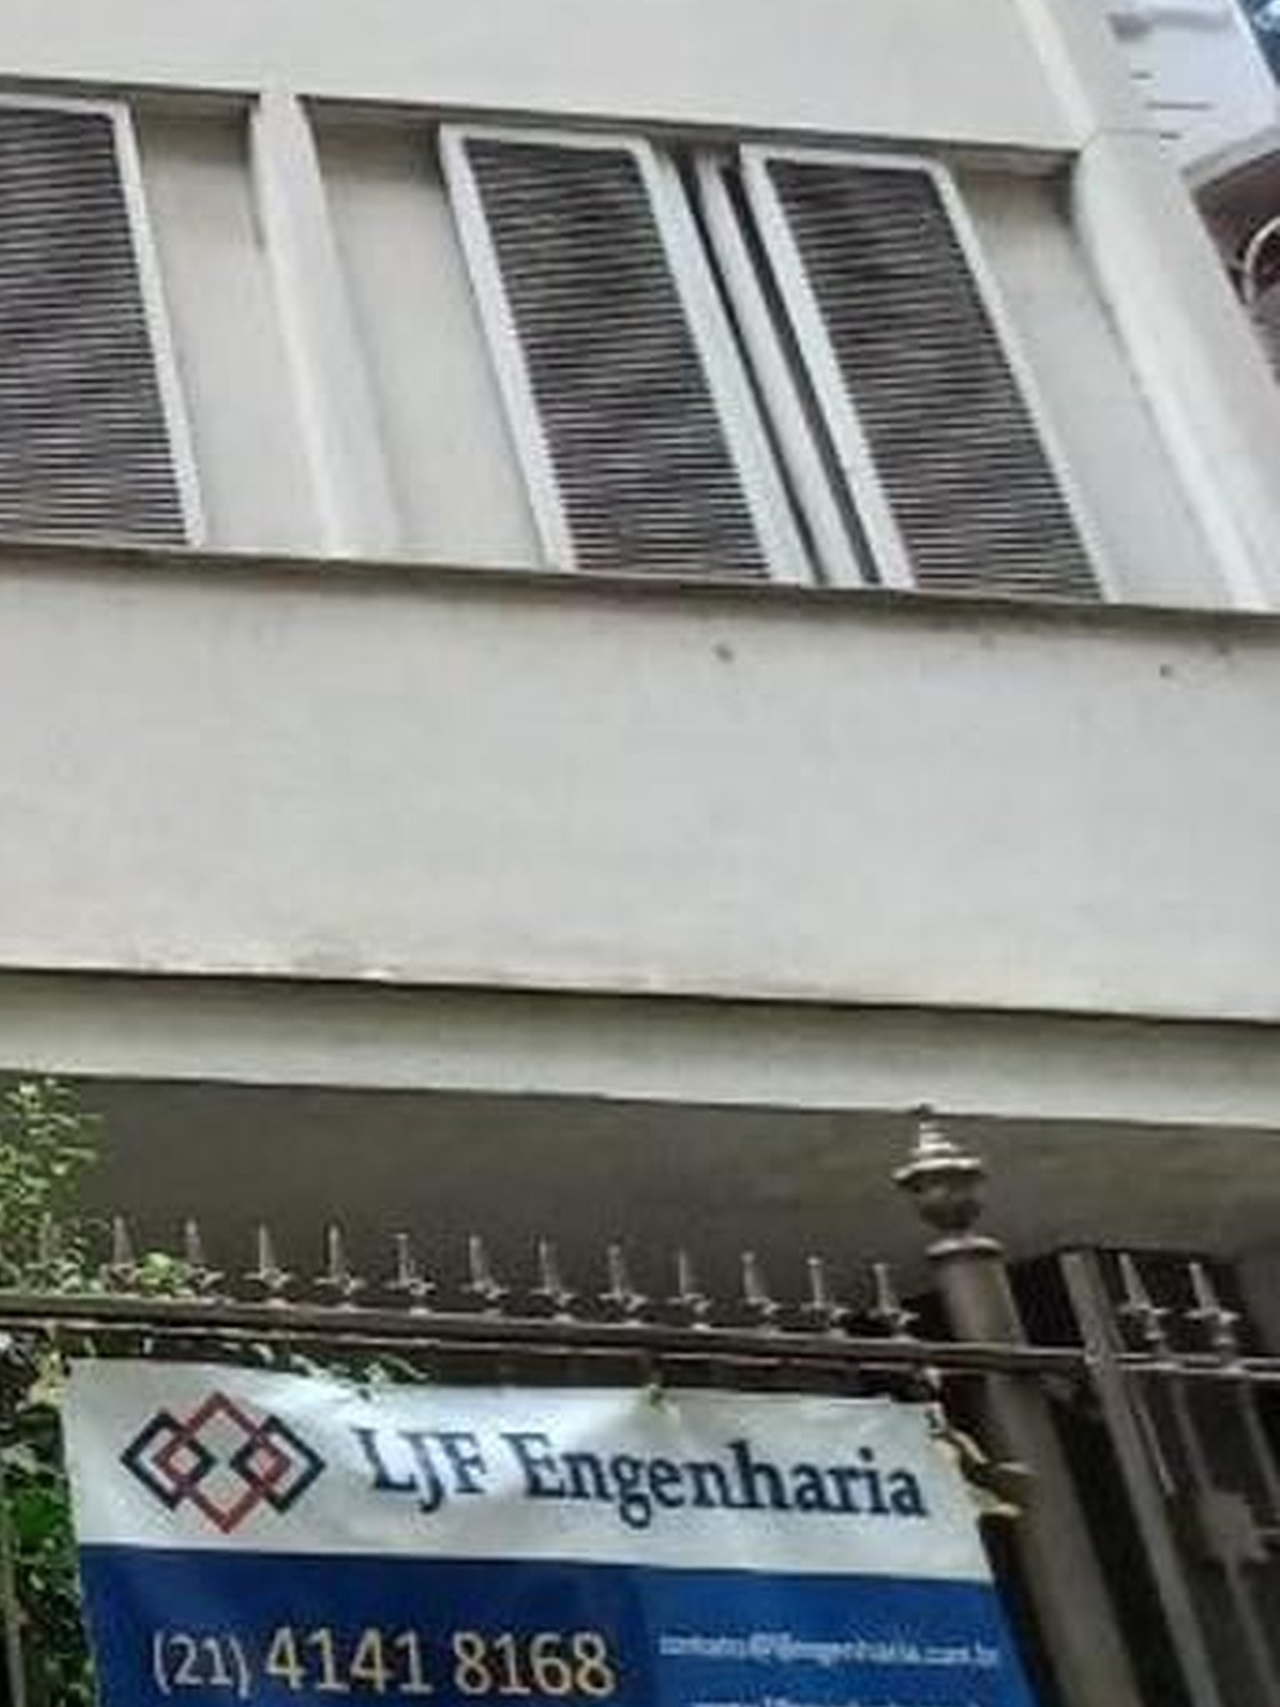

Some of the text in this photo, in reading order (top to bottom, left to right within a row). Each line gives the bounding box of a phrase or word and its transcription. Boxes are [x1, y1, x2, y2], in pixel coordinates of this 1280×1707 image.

[351, 1427, 928, 1530] LJF Engenharia
[152, 1626, 617, 1699] (21) 4141 8168
